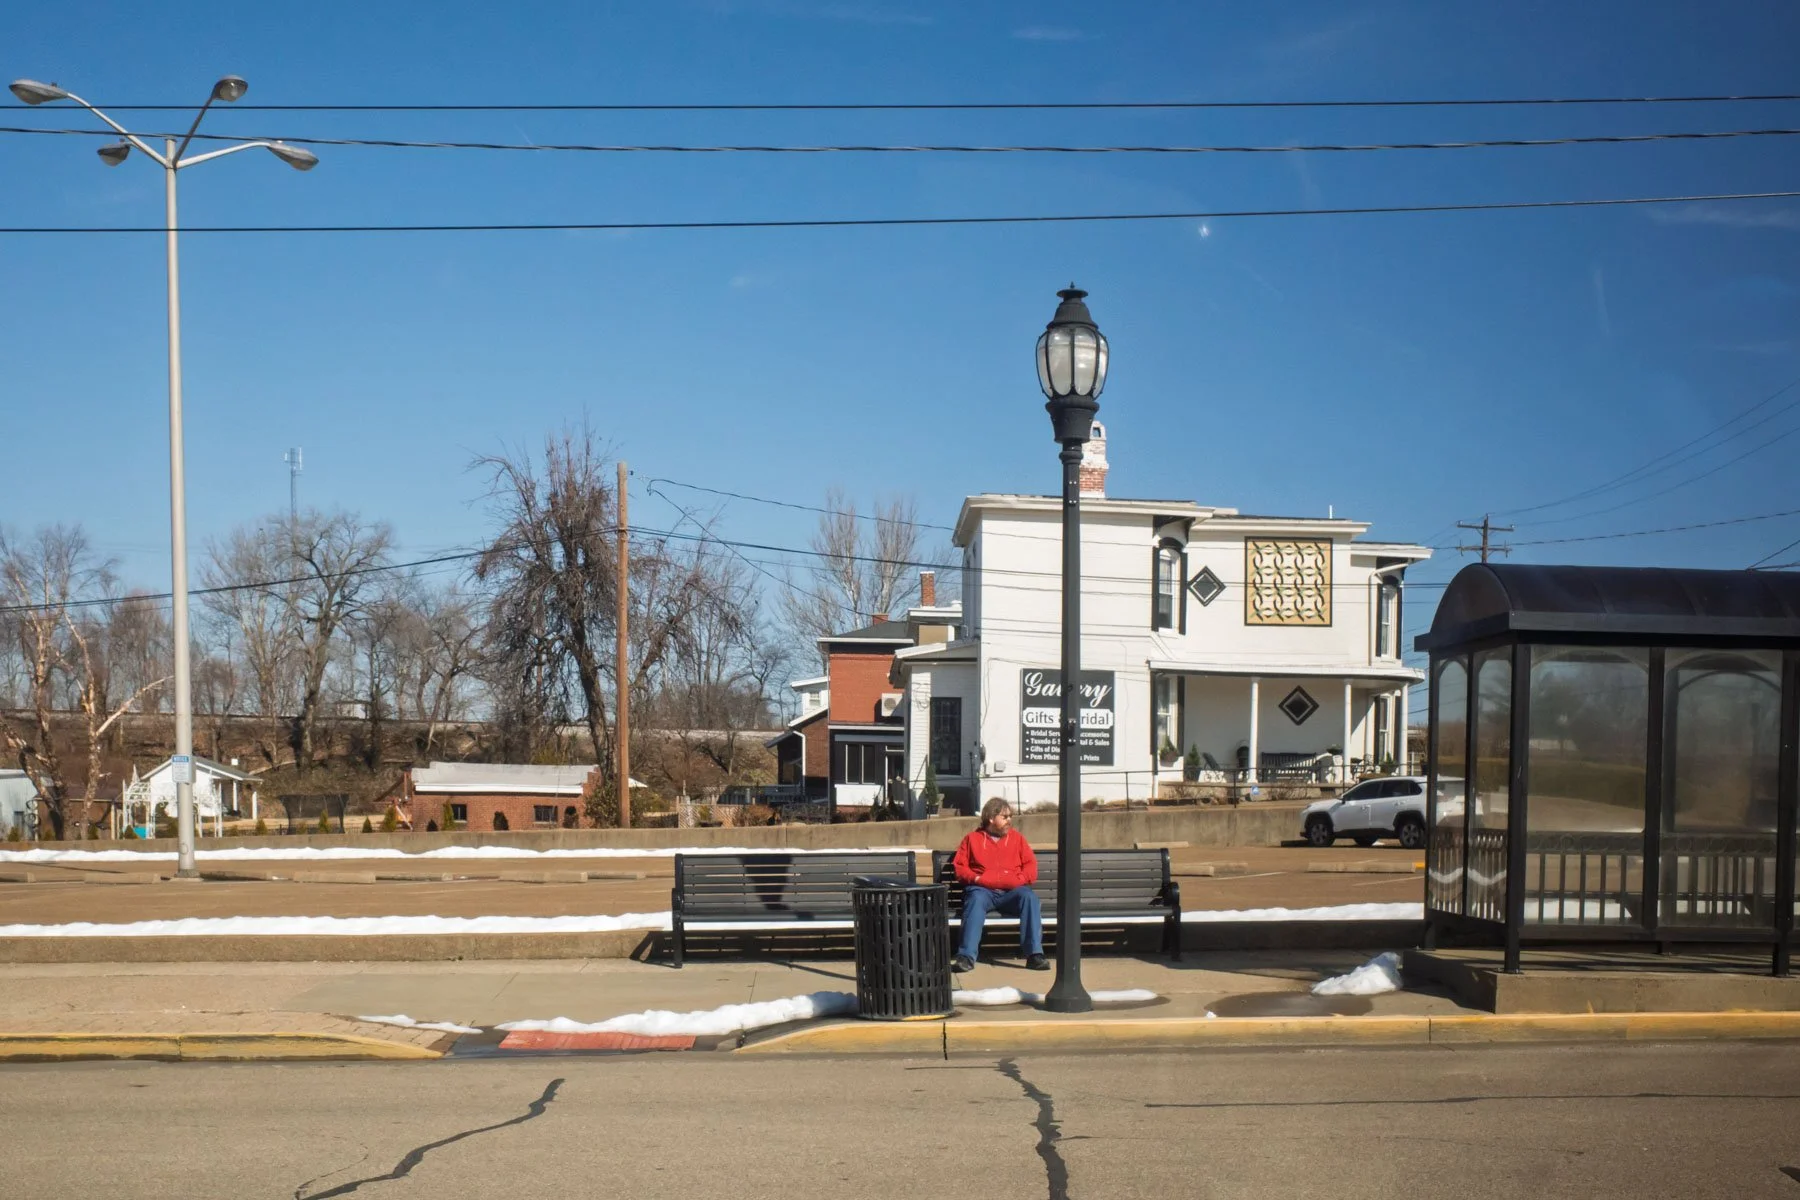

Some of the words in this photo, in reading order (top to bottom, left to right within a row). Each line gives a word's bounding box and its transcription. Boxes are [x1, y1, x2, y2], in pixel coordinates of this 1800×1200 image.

[1024, 671, 1112, 708] Gary
[1025, 711, 1054, 724] Gifts
[1081, 712, 1109, 725] ridal
[1030, 745, 1043, 753] Gifts
